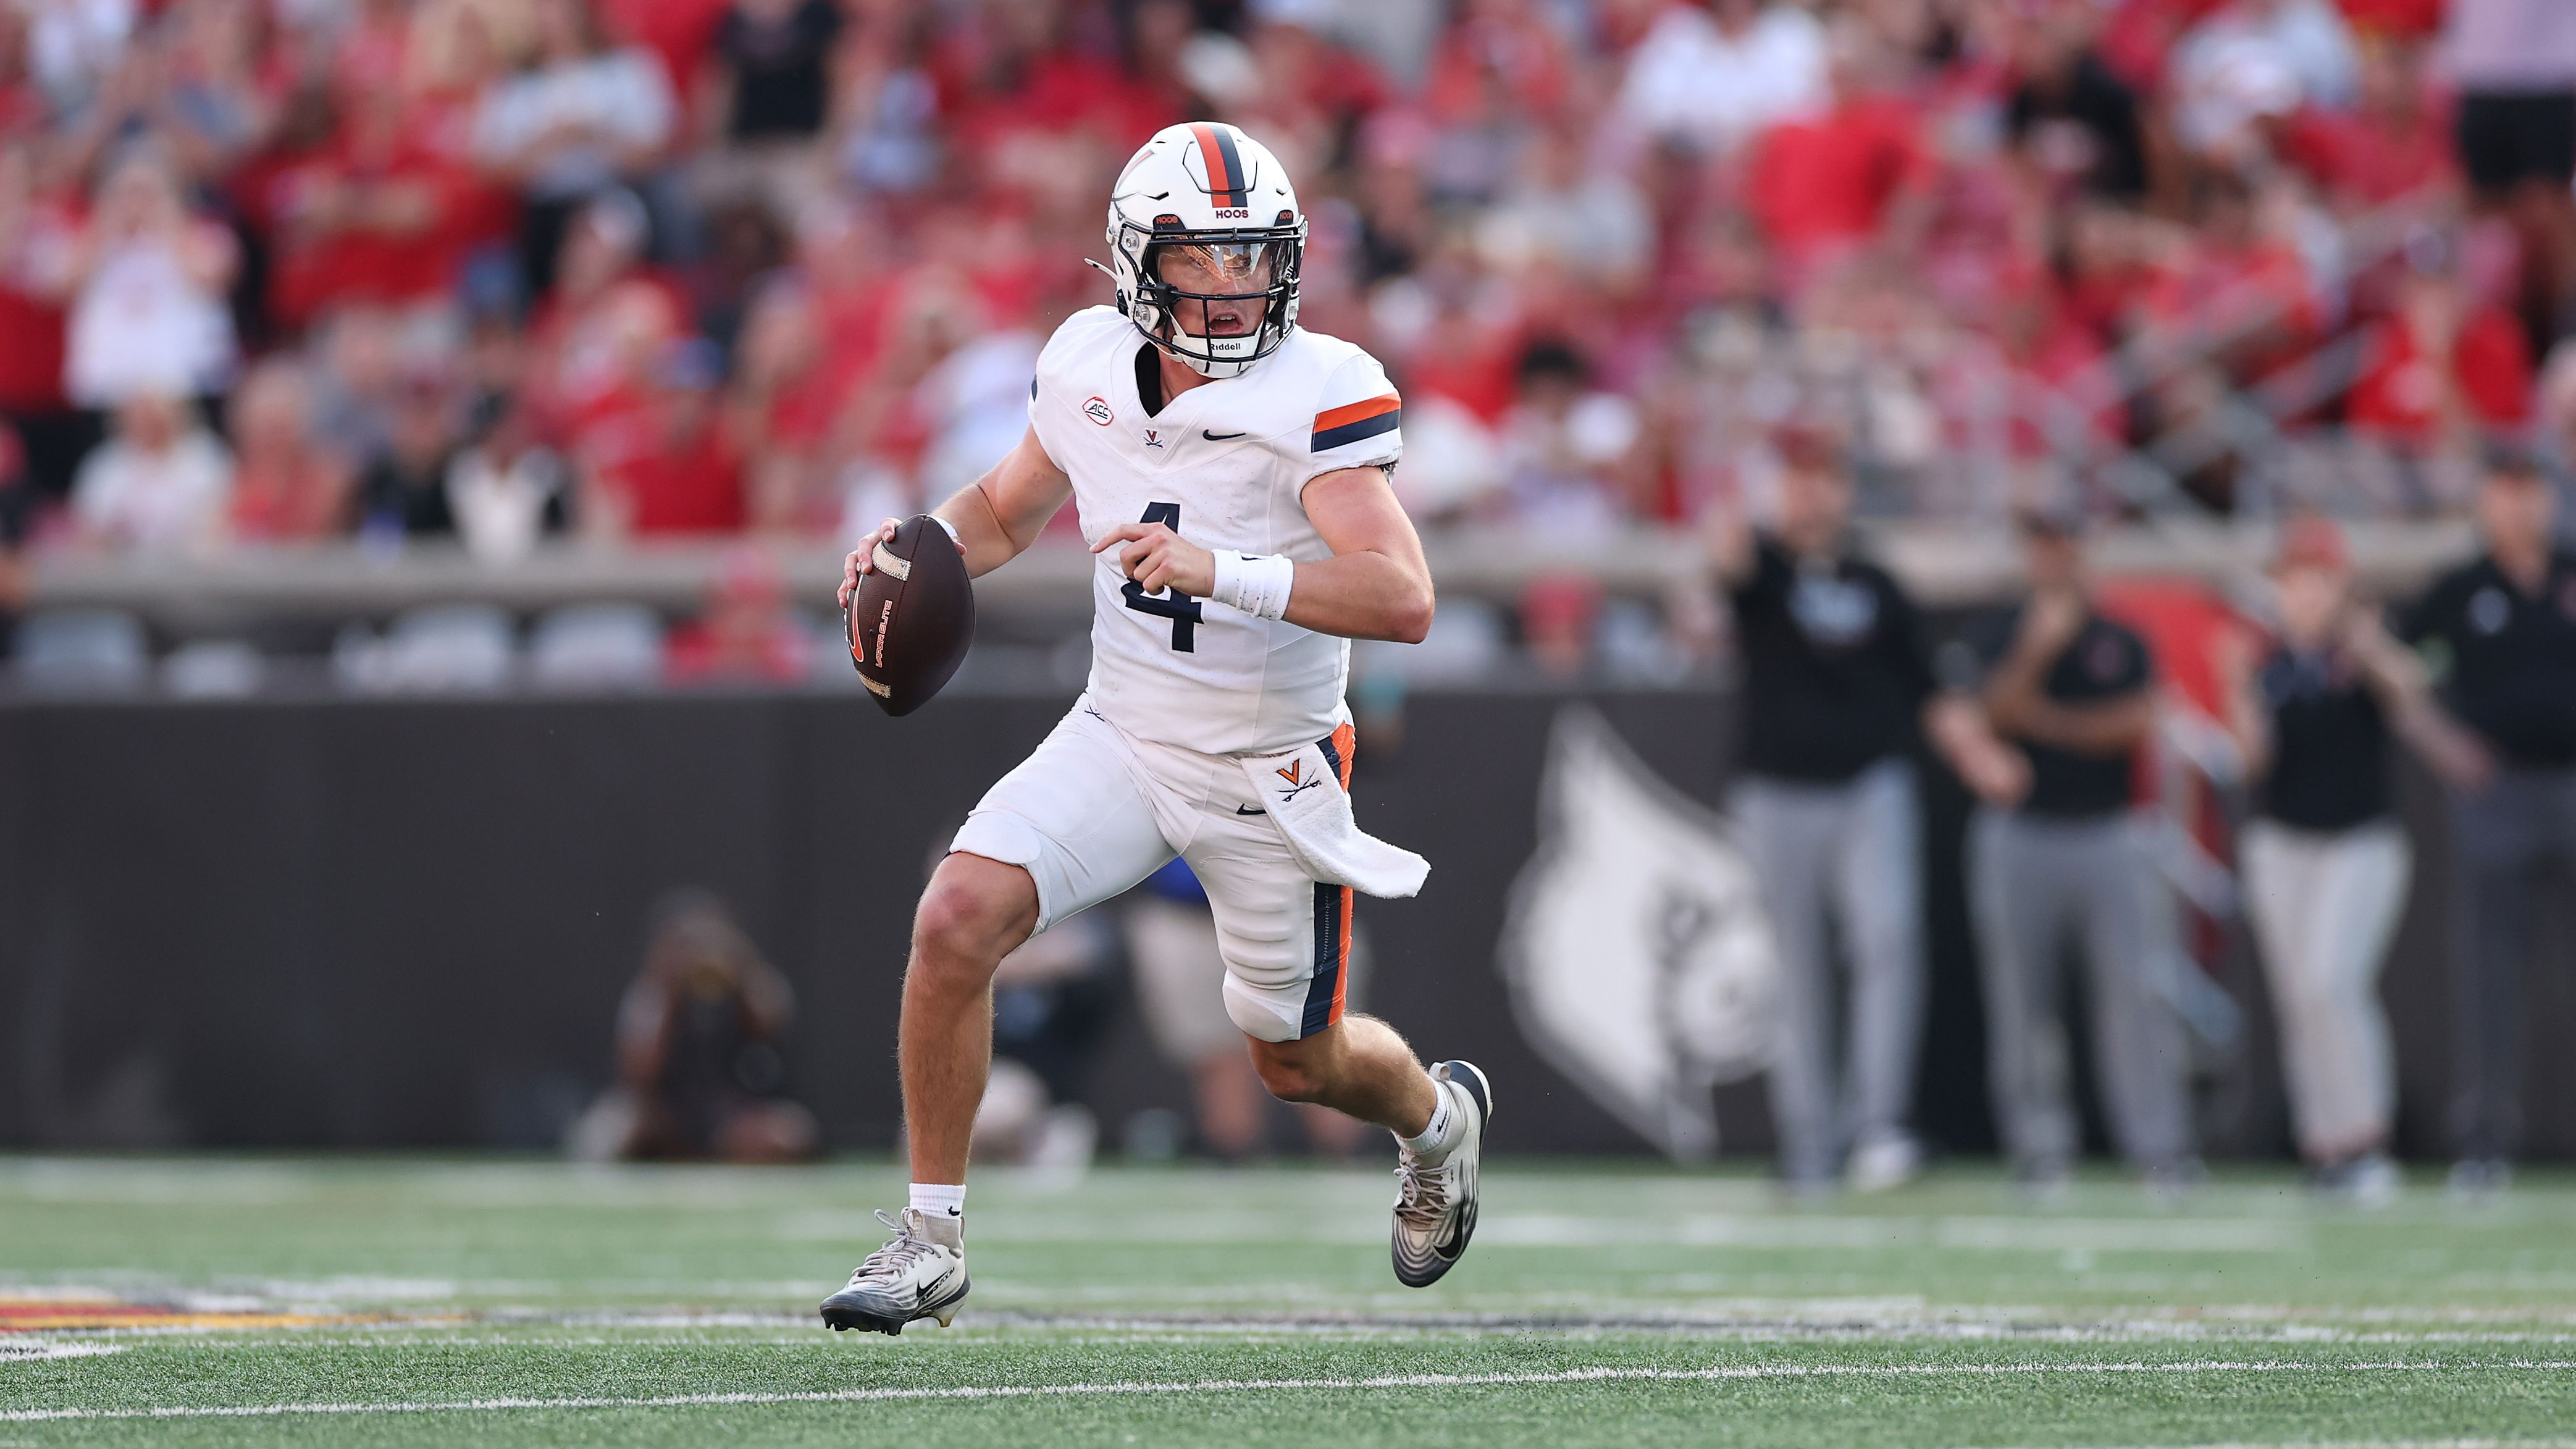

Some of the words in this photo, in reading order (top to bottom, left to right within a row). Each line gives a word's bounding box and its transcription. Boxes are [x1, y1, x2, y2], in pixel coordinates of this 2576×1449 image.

[1216, 210, 1249, 219] HOOS
[1210, 343, 1241, 351] Riddell
[1088, 403, 1109, 417] ACC
[1121, 502, 1202, 653] 4
[879, 600, 892, 634] ELITE
[875, 634, 885, 668] VAPOR
[939, 1266, 955, 1286] ZOOM
